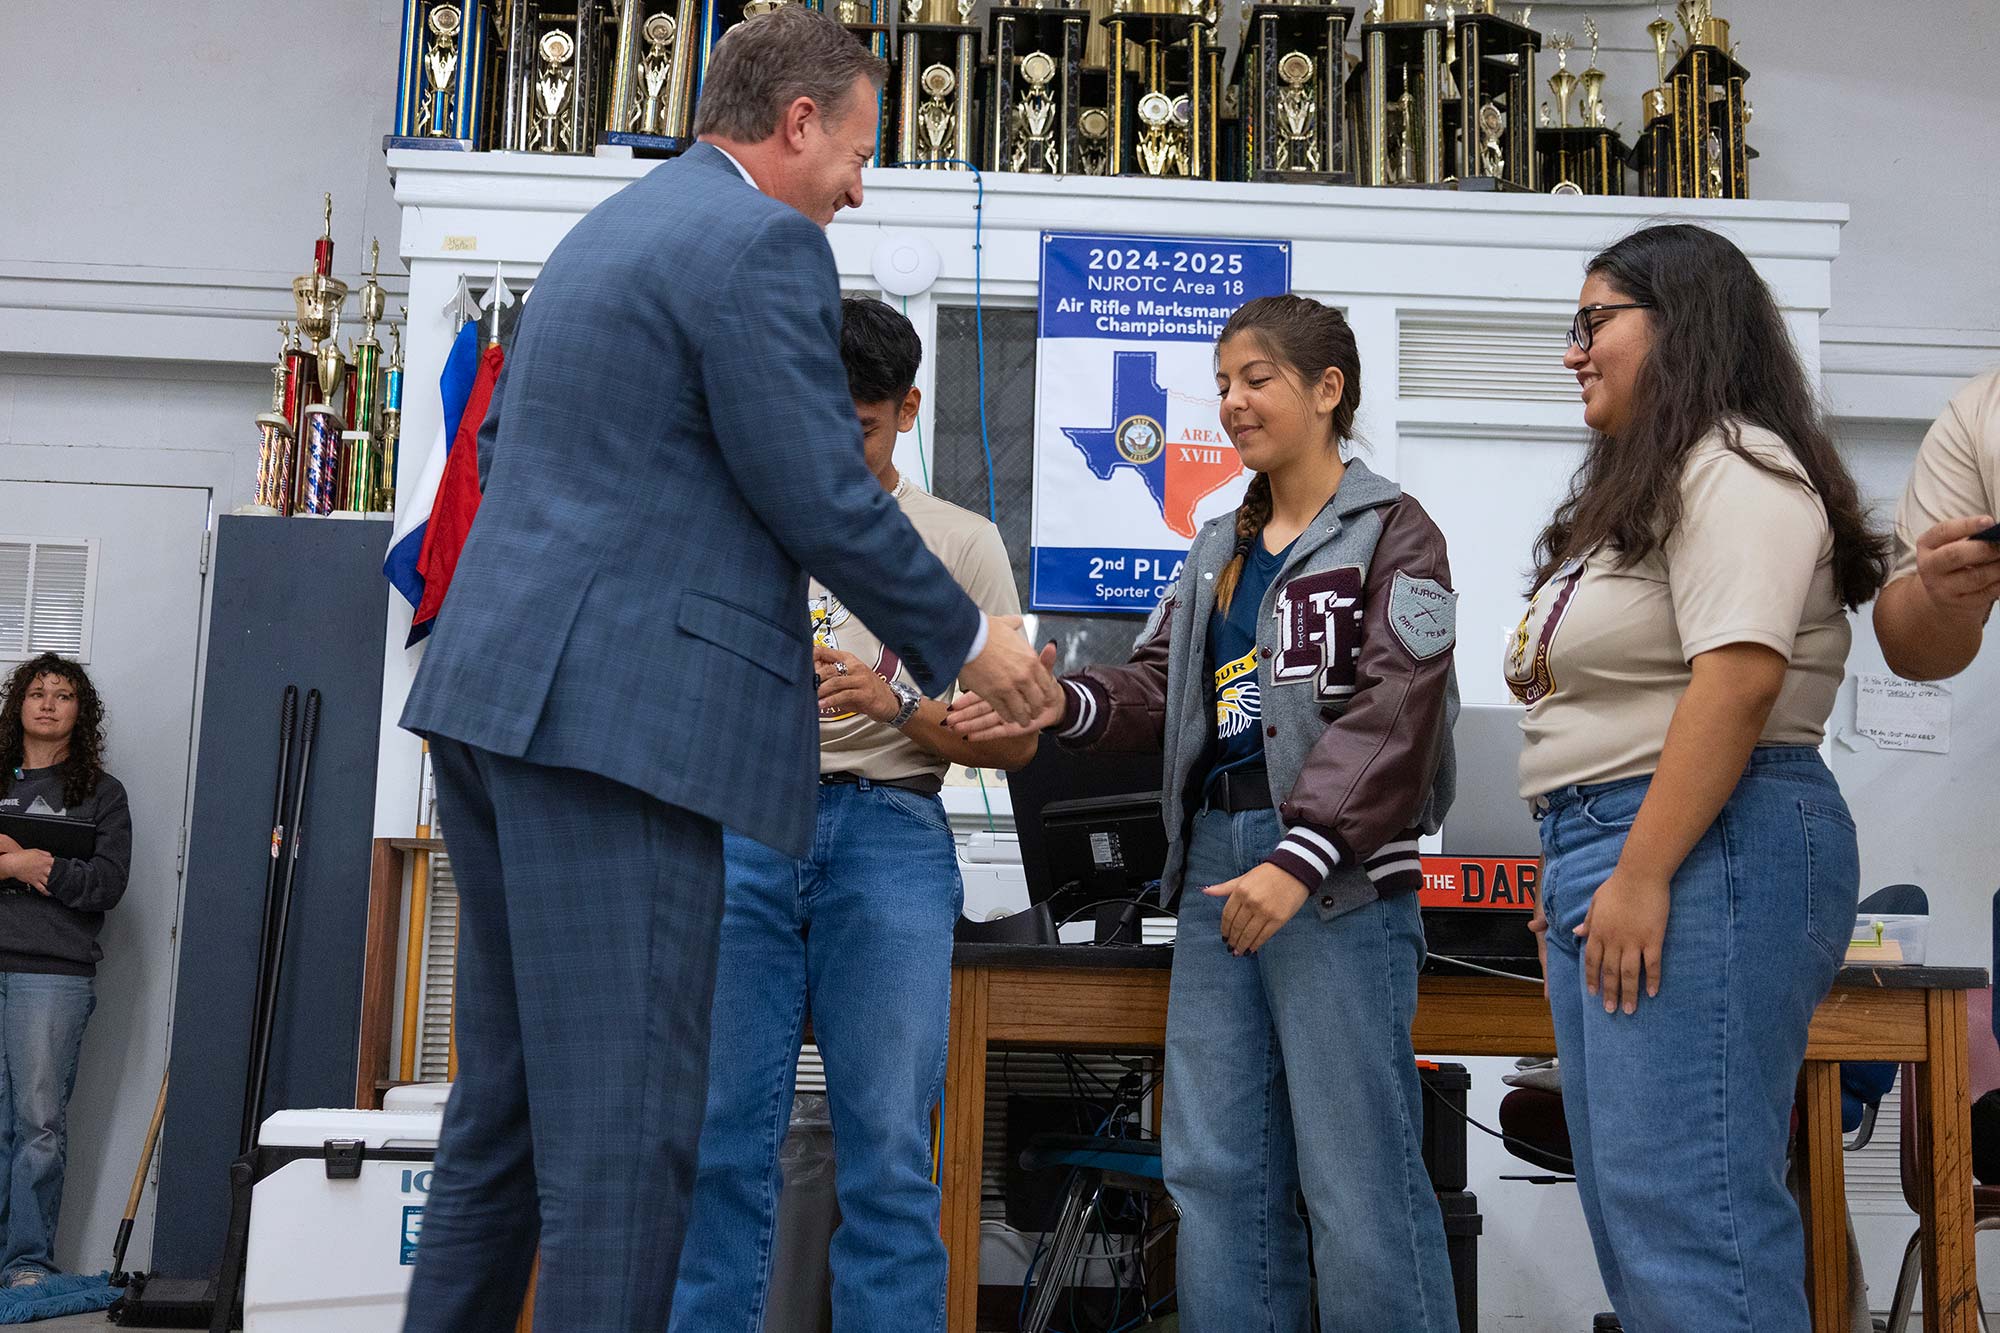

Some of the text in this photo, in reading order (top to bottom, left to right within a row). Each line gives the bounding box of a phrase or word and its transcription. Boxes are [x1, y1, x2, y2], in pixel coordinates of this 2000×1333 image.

[1088, 248, 1243, 275] 2024-2025
[1088, 275, 1244, 296] NJROTC Area 18
[1056, 298, 1244, 319] Air Rifle Marksman
[1179, 428, 1223, 443] AREA
[1179, 447, 1222, 465] XVIII
[1088, 556, 1184, 581] 2nd PLA
[1095, 583, 1150, 601] Sporter
[1410, 586, 1448, 605] NJROTC
[1297, 601, 1305, 649] NJROTC
[1398, 615, 1448, 639] DRILL TEAM
[1423, 863, 1538, 904] THE DAR
